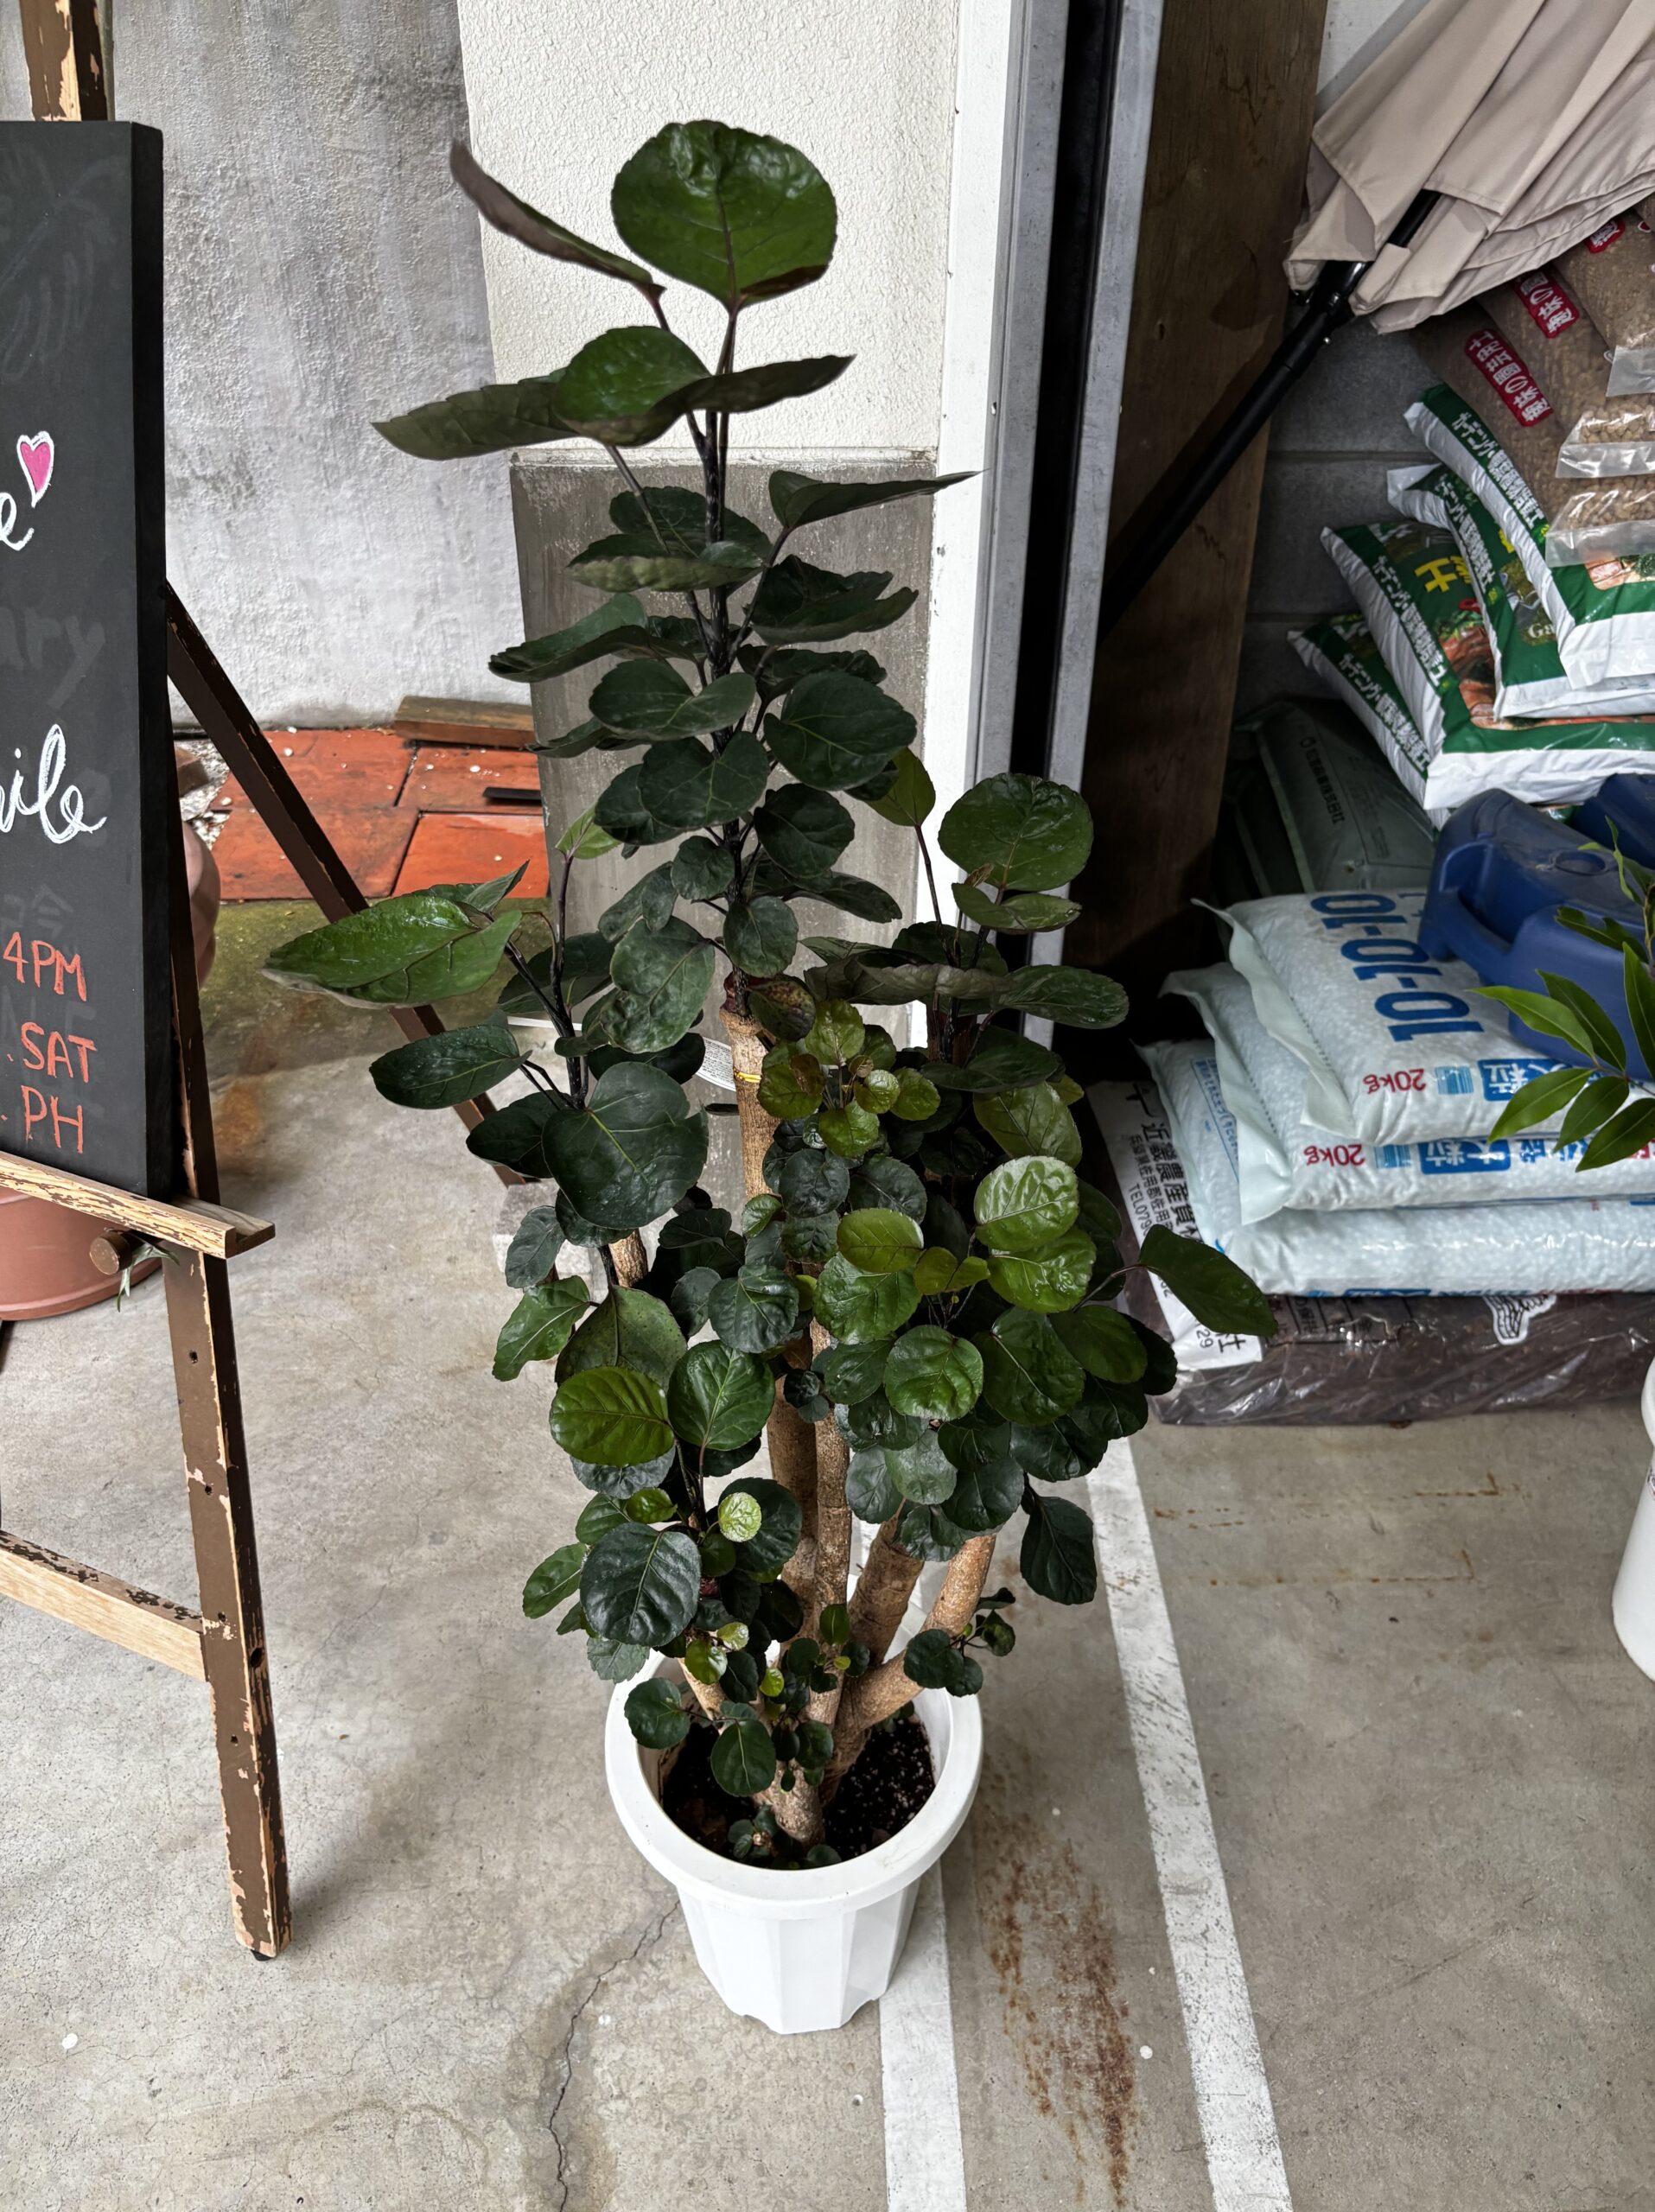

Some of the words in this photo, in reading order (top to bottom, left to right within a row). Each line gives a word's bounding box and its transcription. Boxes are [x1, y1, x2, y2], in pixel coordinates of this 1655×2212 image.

[1469, 330, 1551, 422] 趣味の園芸用土
[3, 931, 87, 1002] 4PM
[1310, 893, 1485, 1042] 10-10-10
[21, 1021, 98, 1084] SAT
[1363, 1068, 1426, 1095] 20kg
[21, 1084, 84, 1154] PH
[1302, 1143, 1365, 1166] 20kg
[1426, 1140, 1506, 1166] 大粒
